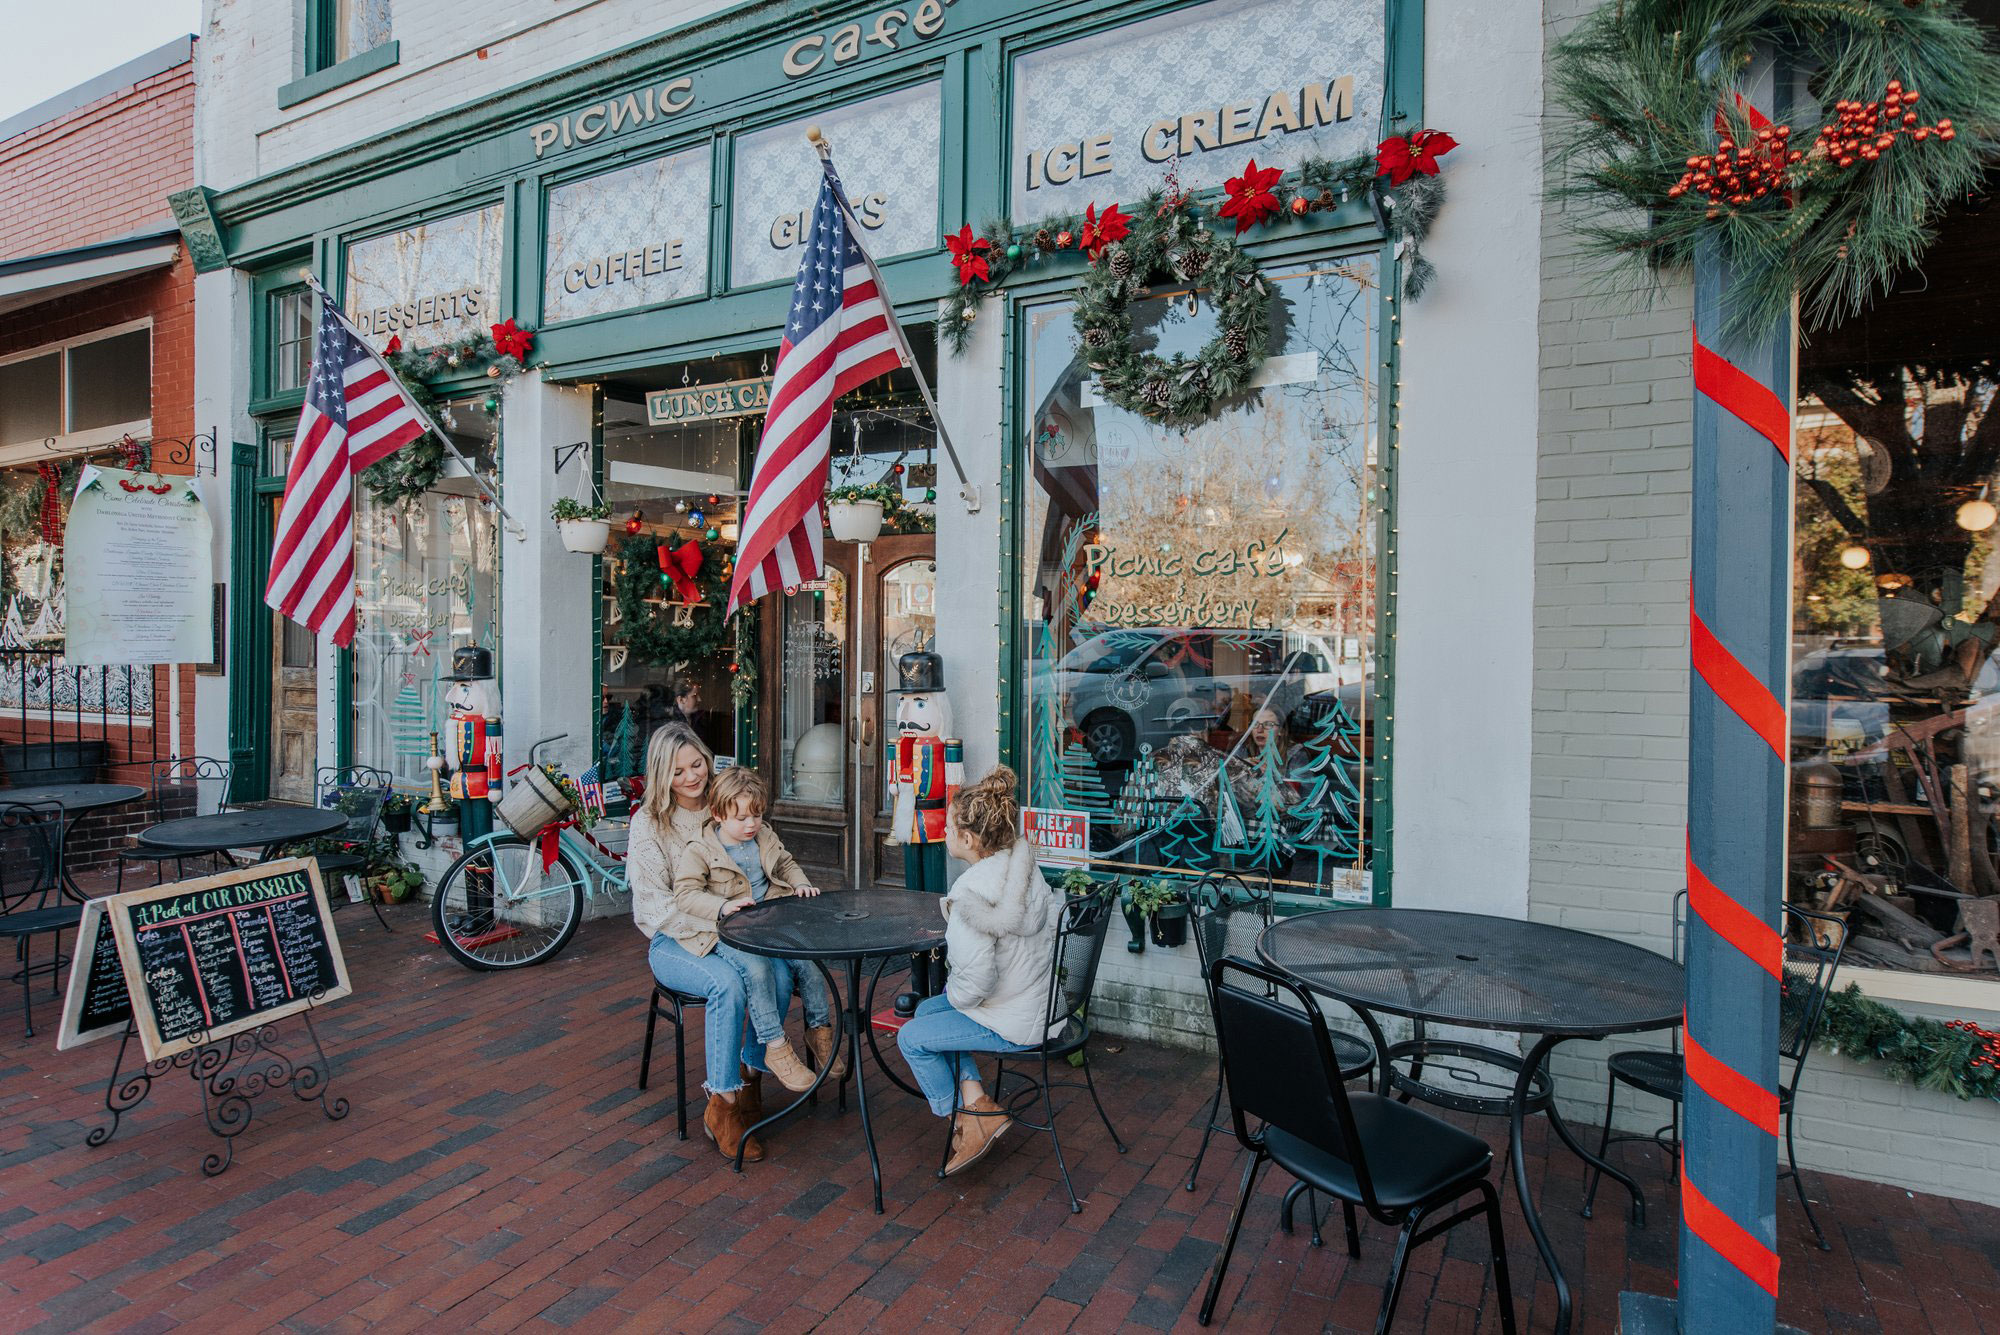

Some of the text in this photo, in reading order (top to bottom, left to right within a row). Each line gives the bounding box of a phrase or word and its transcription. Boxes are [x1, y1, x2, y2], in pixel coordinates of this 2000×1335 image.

[530, 77, 695, 158] PICNIC
[1026, 75, 1355, 192] ICE CREAM
[770, 192, 888, 250] GIS
[563, 238, 684, 294] COFFEE
[356, 286, 483, 337] DESSERTS
[655, 384, 770, 420] LUNCH CA
[1083, 543, 1182, 578] Picnic
[381, 575, 423, 597] Picnic
[1104, 593, 1257, 627] Dessertery
[1037, 813, 1072, 831] HELP
[1026, 829, 1083, 849] WANTED
[137, 907, 152, 925] A
[183, 896, 200, 915] at
[203, 888, 232, 910] OUR
[235, 874, 307, 903] DESSERTS
[270, 898, 308, 912] Ice Cream
[236, 911, 250, 919] Pies
[241, 937, 264, 948] Lemon
[145, 967, 176, 983] Cookies
[249, 961, 274, 972] Muffins
[252, 974, 275, 985] Scones
